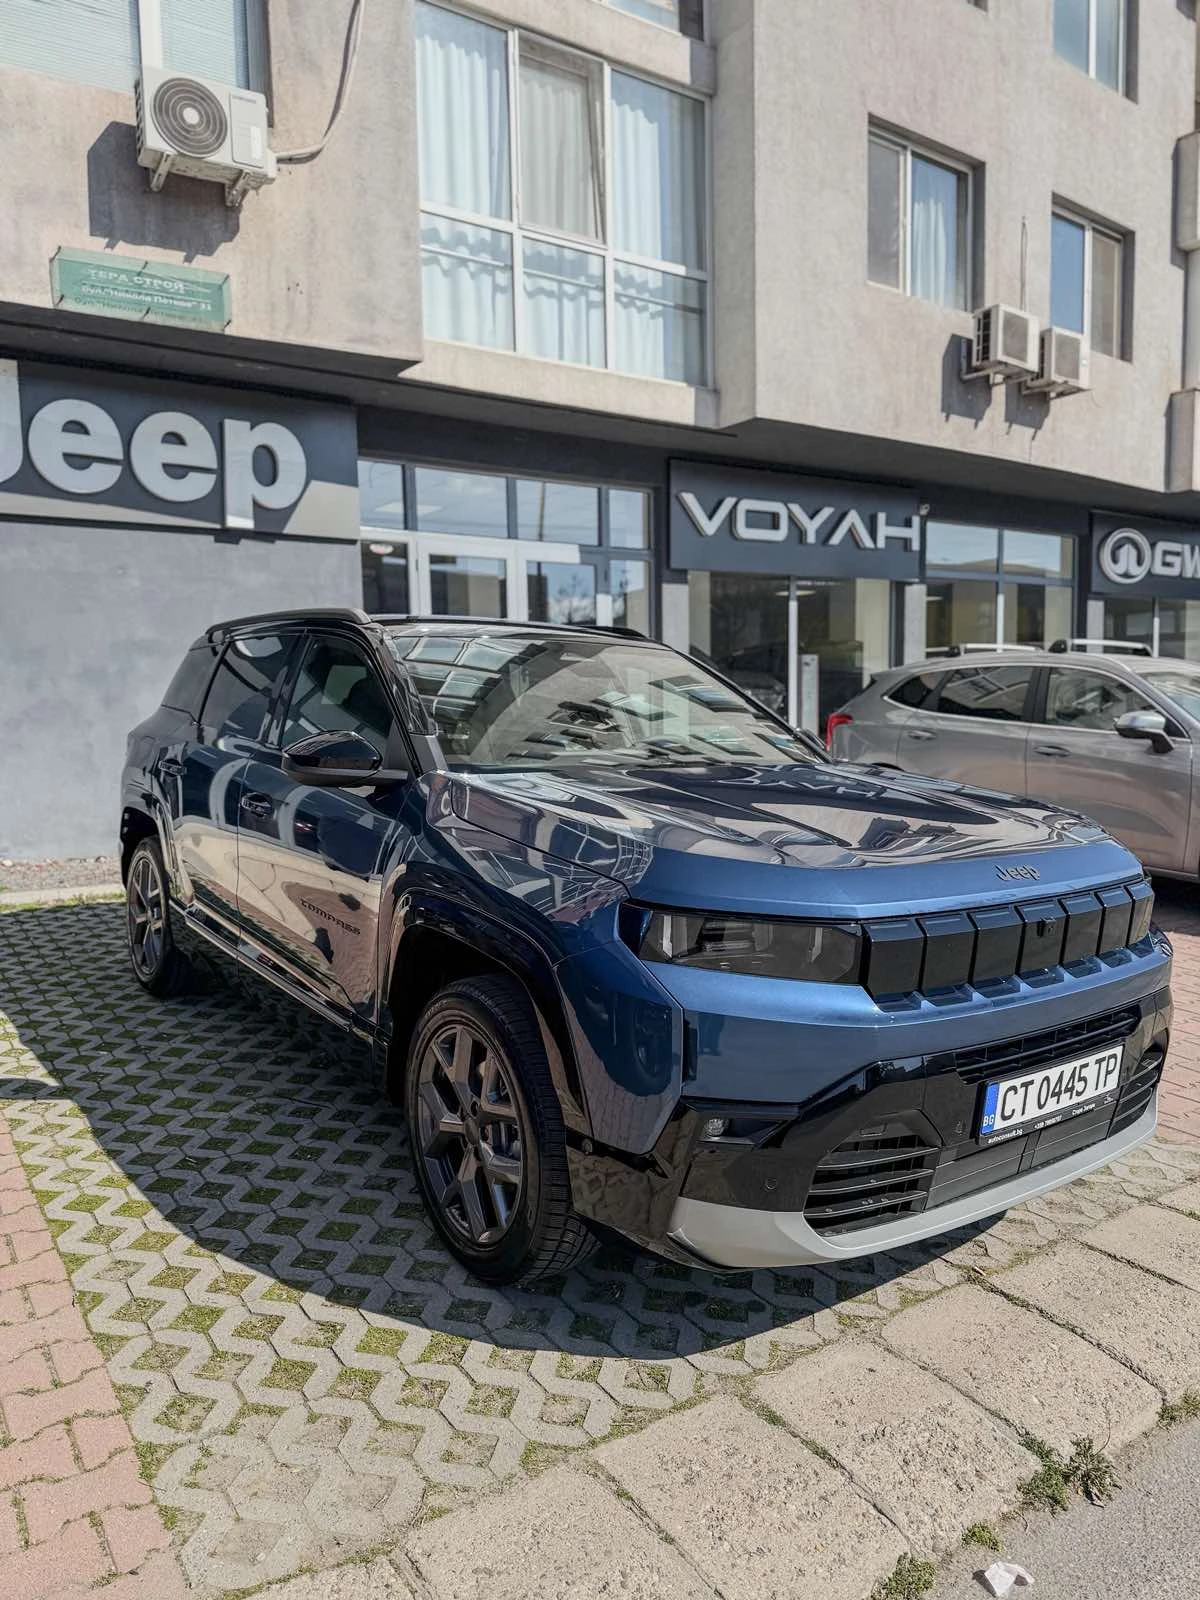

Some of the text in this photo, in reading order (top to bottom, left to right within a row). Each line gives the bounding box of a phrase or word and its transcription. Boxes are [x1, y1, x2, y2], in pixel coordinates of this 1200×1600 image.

[676, 491, 920, 551] VOYAH
[994, 864, 1041, 881] Jeep
[300, 898, 361, 935] COMPASS
[1001, 1053, 1118, 1121] CT 0445 TP
[982, 1113, 995, 1126] BG
